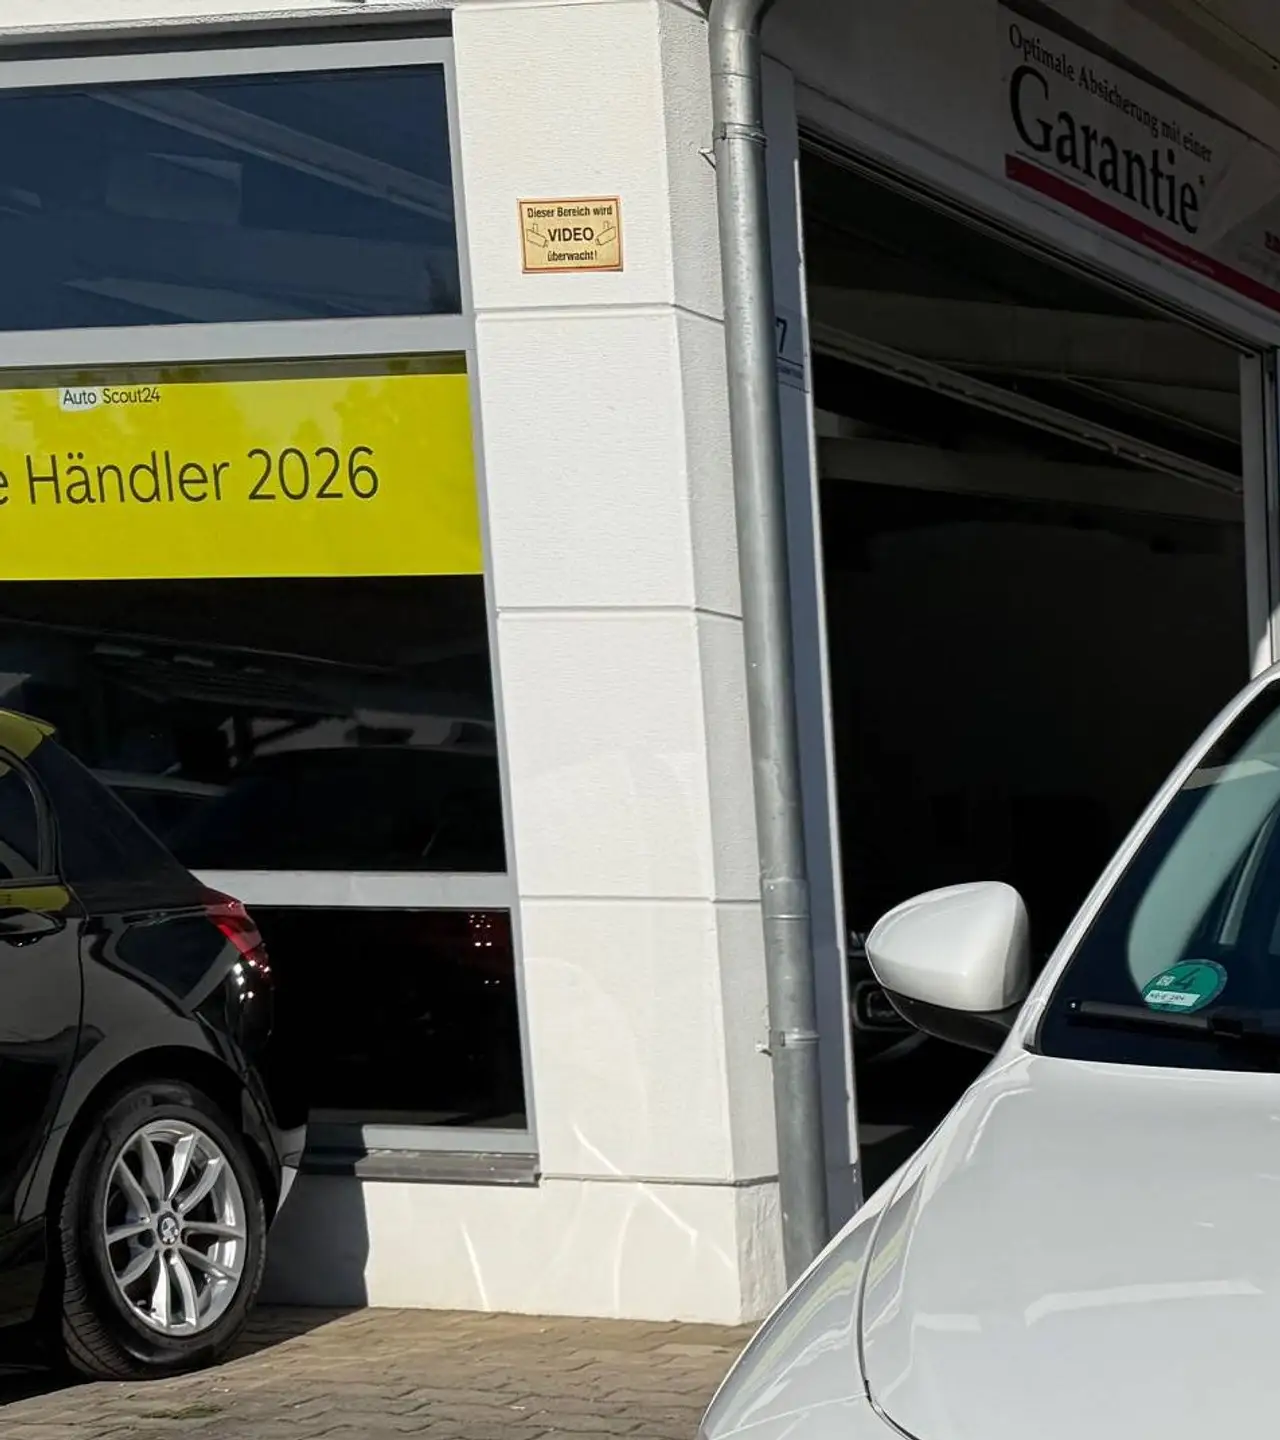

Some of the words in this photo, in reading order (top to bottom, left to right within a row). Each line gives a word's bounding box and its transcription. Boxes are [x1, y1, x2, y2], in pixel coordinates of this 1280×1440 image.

[1009, 23, 1075, 81] Optimale
[1079, 67, 1160, 139] Absicherung
[1161, 120, 1181, 145] mit
[527, 207, 554, 218] Dieser
[557, 206, 590, 217] Bereich
[593, 204, 613, 216] wird
[548, 227, 595, 242] VIDEO
[26, 449, 230, 504] Händler
[247, 445, 379, 500] 2026
